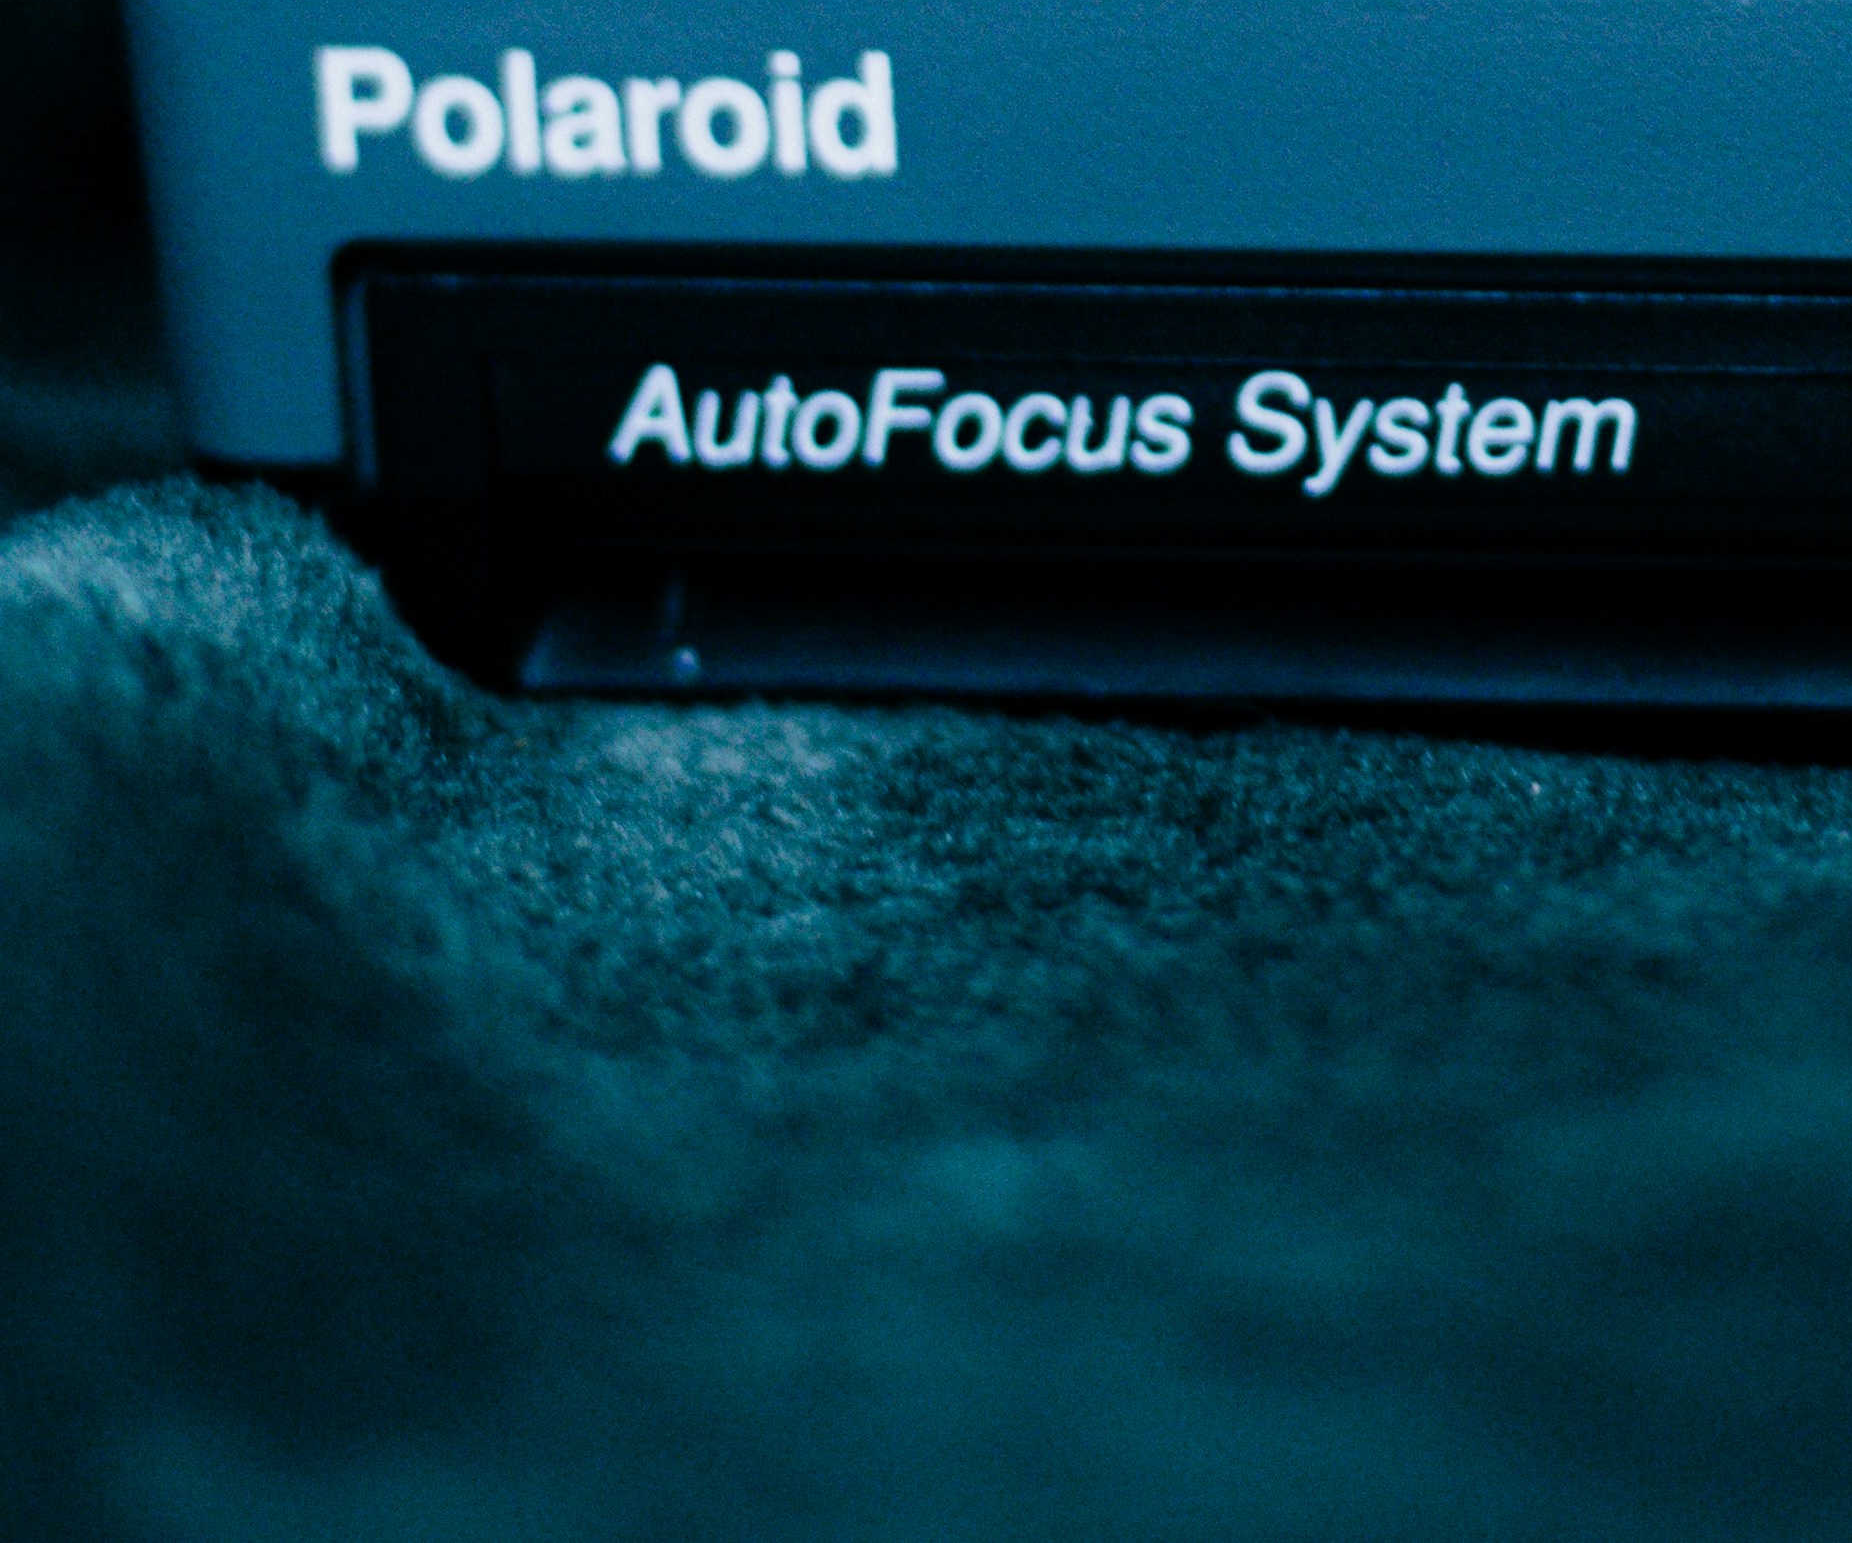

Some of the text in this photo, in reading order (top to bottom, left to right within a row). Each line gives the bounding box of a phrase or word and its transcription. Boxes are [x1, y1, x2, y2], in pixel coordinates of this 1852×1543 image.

[314, 45, 899, 179] Polaroid
[609, 364, 1639, 495] AutoFocus System
